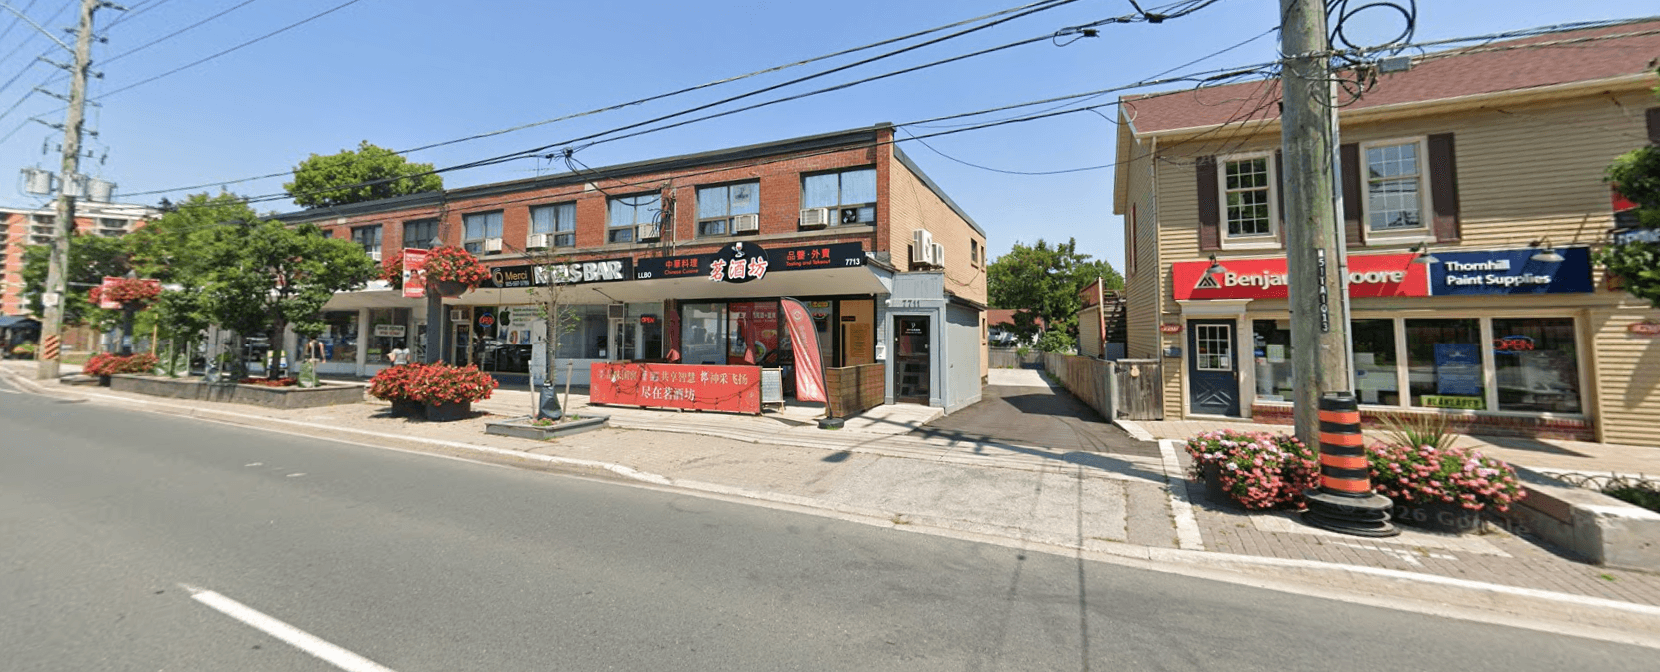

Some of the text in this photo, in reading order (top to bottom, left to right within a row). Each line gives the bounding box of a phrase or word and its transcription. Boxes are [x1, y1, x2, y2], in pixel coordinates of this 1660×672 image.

[665, 258, 698, 268] 中華料理
[845, 258, 860, 266] 7713
[1445, 259, 1511, 271] Thornhill
[505, 270, 528, 281] Merci
[583, 260, 623, 281] BAR
[638, 271, 652, 279] LLBO
[708, 256, 768, 282] 茗酒坊
[1224, 270, 1405, 289] Benja oore
[1446, 273, 1551, 287] Paint Supplies
[641, 385, 696, 401] 尽在茗酒坊
